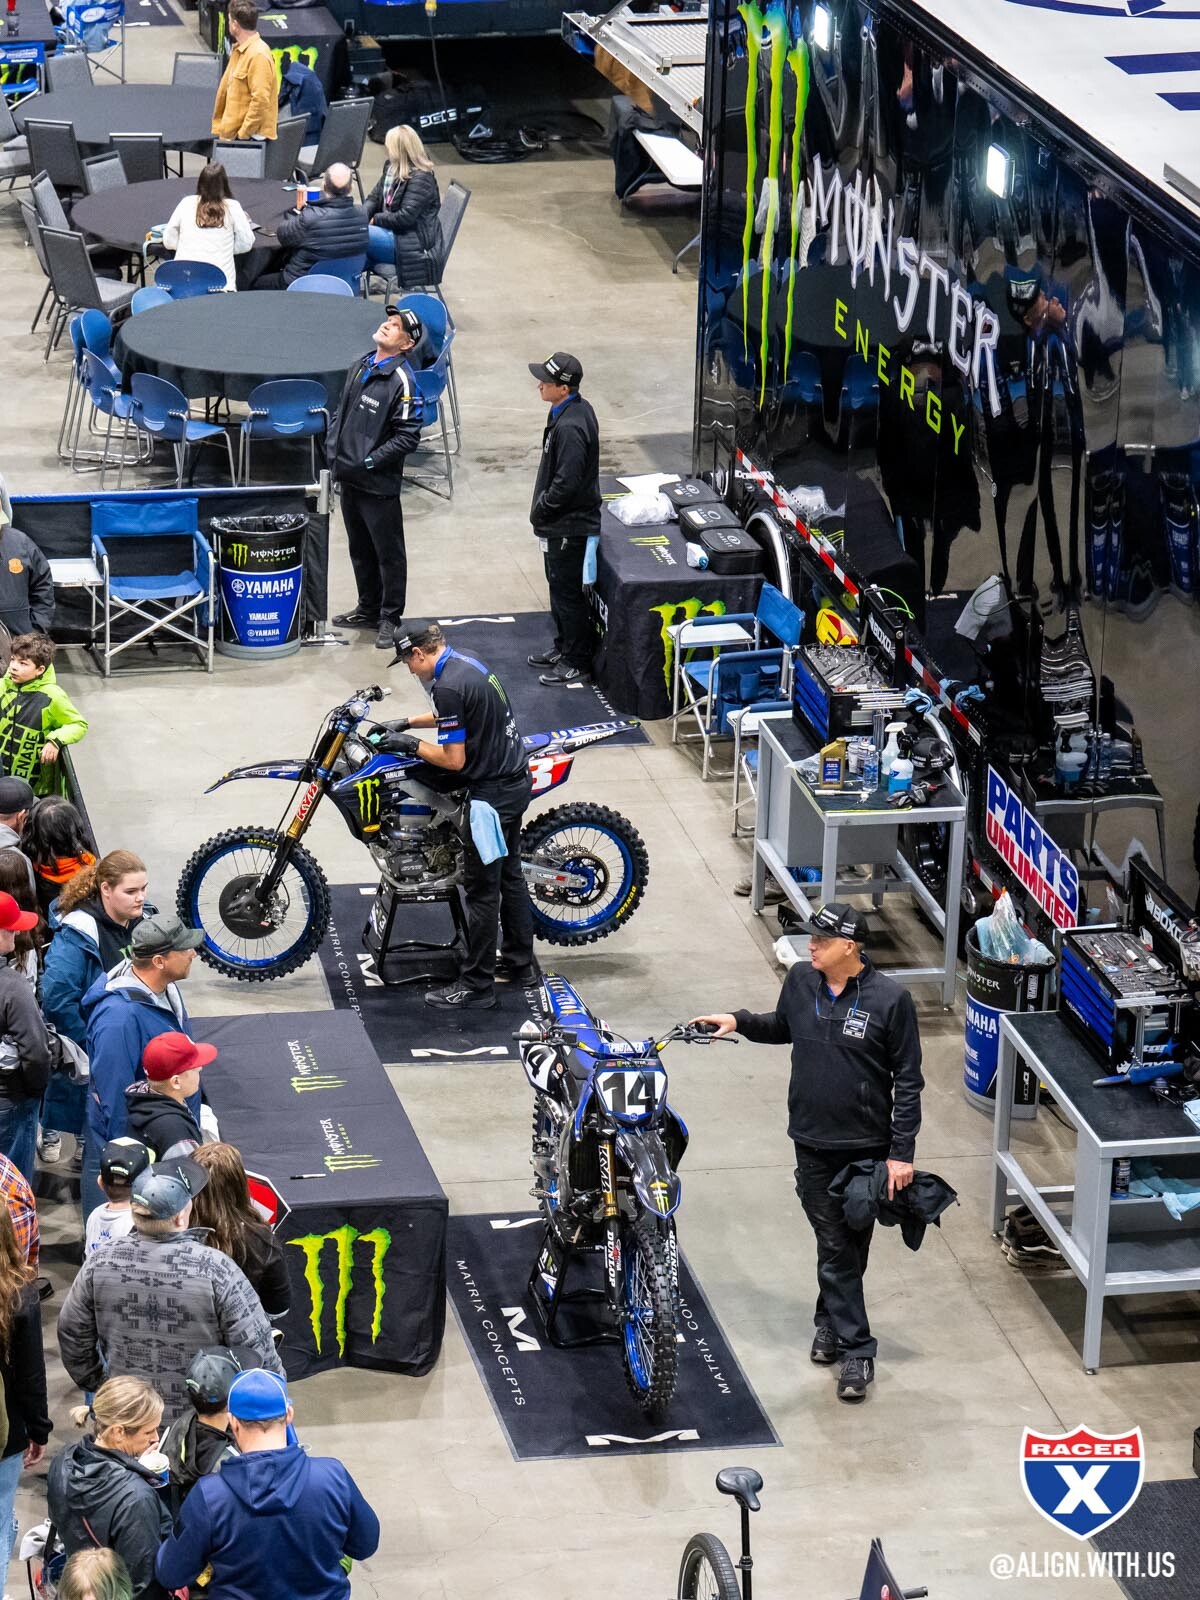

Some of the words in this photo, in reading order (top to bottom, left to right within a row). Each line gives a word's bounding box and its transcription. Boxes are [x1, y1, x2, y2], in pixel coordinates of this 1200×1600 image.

[809, 153, 1000, 417] MONSTER
[833, 296, 966, 456] ENERGY
[250, 546, 296, 557] MONSTER
[246, 577, 295, 594] YAMAHA
[248, 612, 280, 620] YAMALUBE
[255, 629, 280, 637] YAMAHA
[14, 732, 38, 779] ENADE
[988, 765, 1079, 912] PARTS
[987, 811, 1077, 929] UNLIMITED
[615, 885, 637, 918] DUNLOP
[326, 917, 343, 957] ATRIX
[966, 1007, 998, 1034] MAHA
[602, 1072, 658, 1113] 14
[319, 1118, 345, 1156] MONSTER
[606, 1230, 616, 1288] DUNLOP
[455, 1259, 487, 1313] MATRIX
[482, 1319, 526, 1405] CONCEPTS
[695, 1338, 731, 1394] MATRIX
